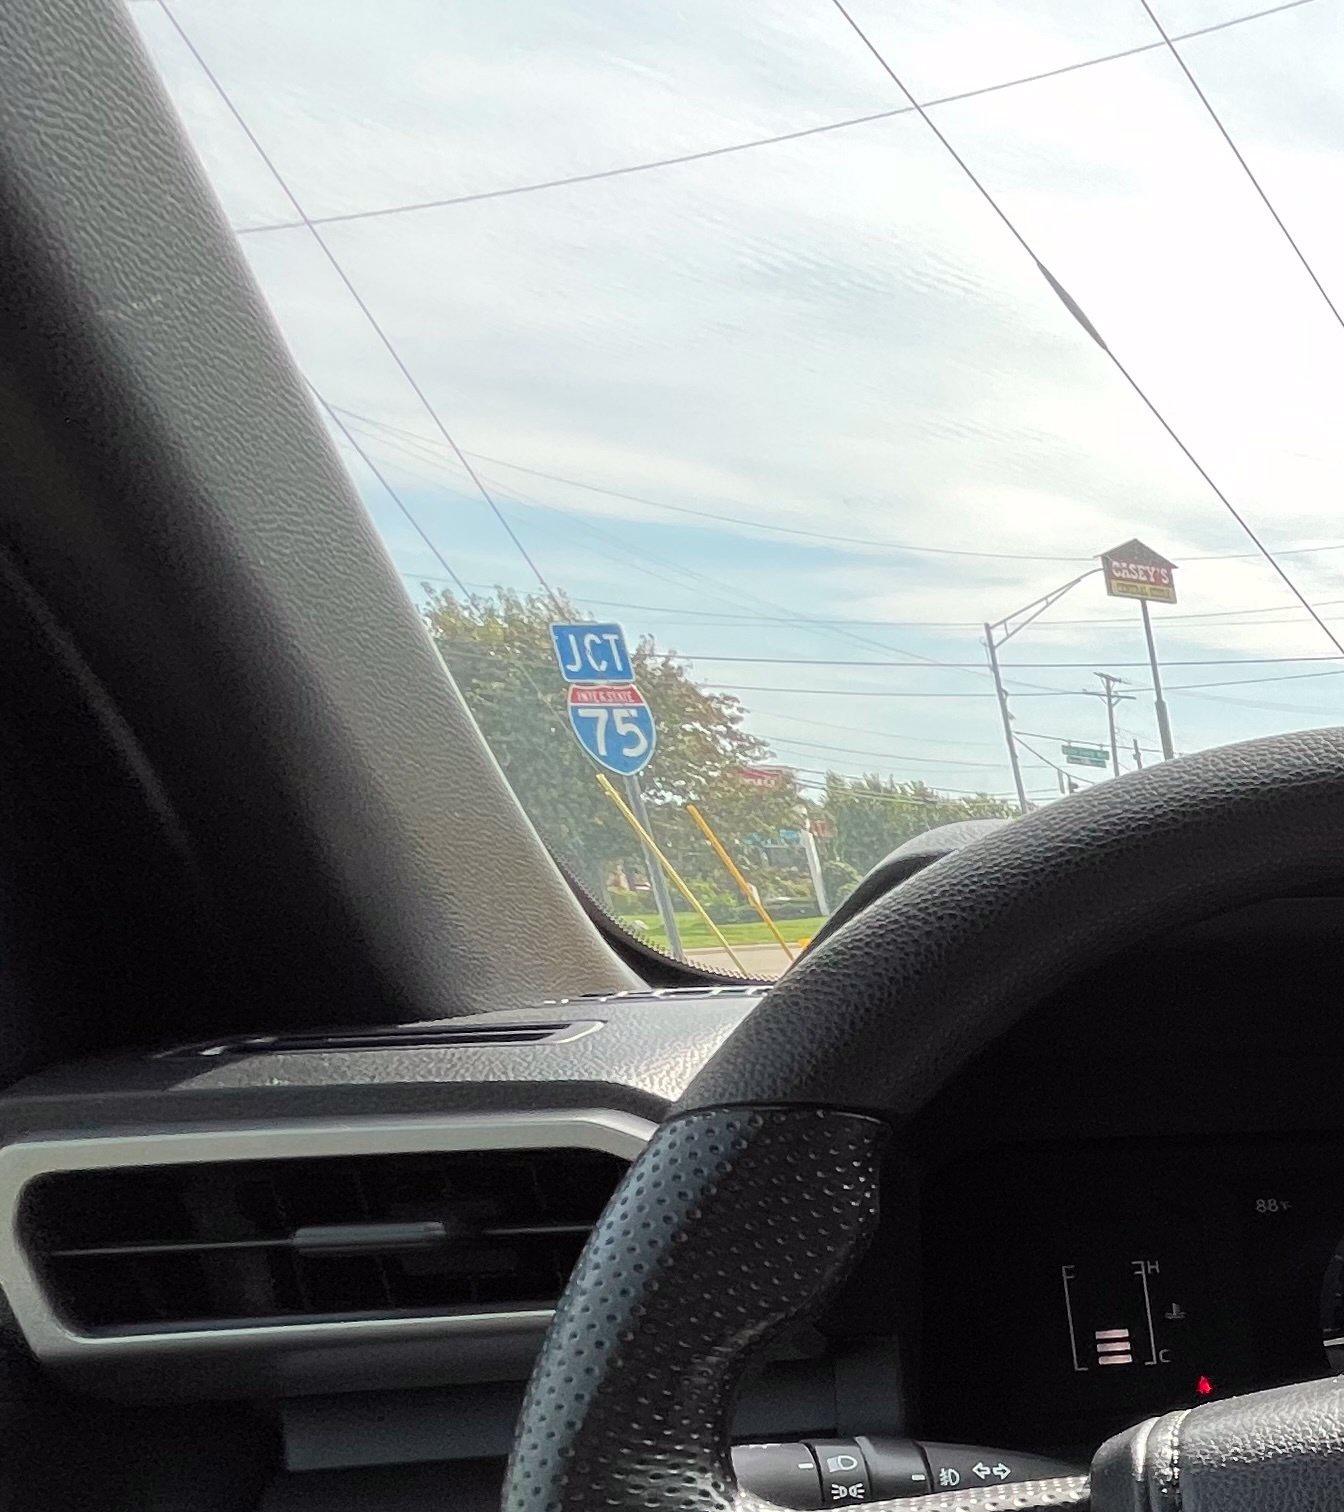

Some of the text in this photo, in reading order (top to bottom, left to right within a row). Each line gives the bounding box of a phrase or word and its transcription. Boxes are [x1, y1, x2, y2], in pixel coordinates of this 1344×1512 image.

[1112, 561, 1169, 584] CASEY'S
[566, 633, 624, 672] JCT
[576, 690, 635, 703] INTERSTATE
[577, 708, 648, 757] 75
[1147, 1260, 1160, 1274] H
[1159, 1349, 1172, 1363] C
